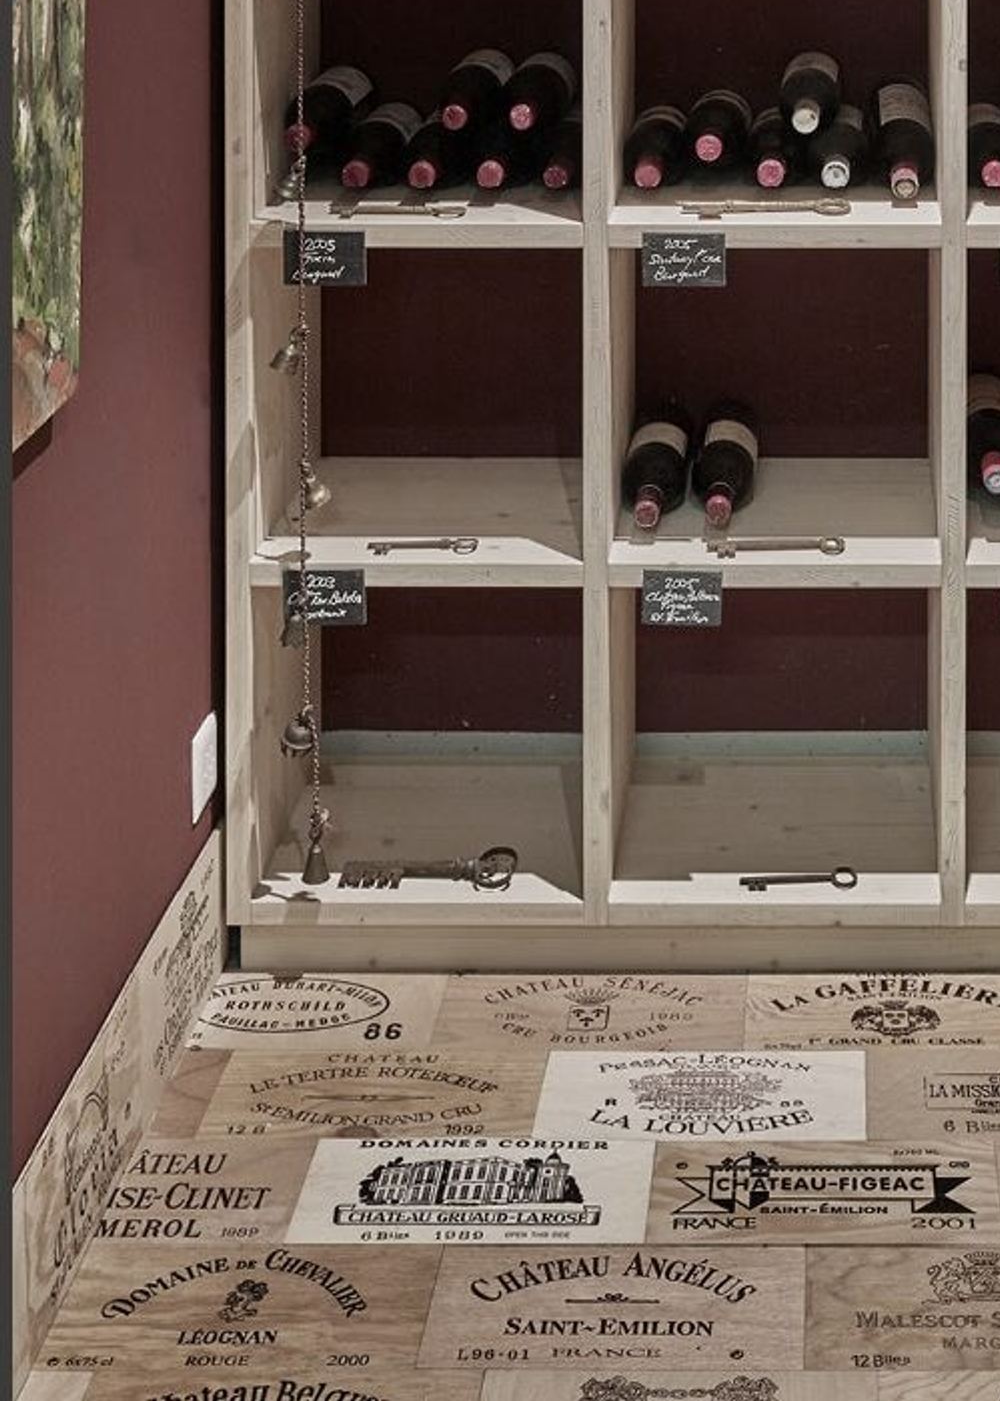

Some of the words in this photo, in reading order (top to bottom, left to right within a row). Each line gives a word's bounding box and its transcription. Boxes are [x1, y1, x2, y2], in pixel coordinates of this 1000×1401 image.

[304, 238, 336, 253] 2005
[485, 977, 586, 1005] CHATEAU
[225, 1001, 346, 1011] ROTHSCHILD
[771, 994, 808, 1012] LA
[363, 1022, 402, 1041] 86
[502, 1022, 537, 1038] CRU
[550, 1024, 668, 1044] BOURGEOIS
[829, 1038, 882, 1046] GRAND
[890, 1038, 921, 1046] CRU
[327, 1054, 440, 1063] CHATEAU
[249, 1078, 280, 1094] LE
[281, 1067, 369, 1085] TERTRE
[928, 1083, 949, 1098] LA
[363, 1112, 434, 1126] GRAND
[440, 1103, 482, 1120] CRU
[589, 1109, 631, 1130] LA
[225, 1124, 245, 1135] 12
[444, 1124, 485, 1135] 1992
[943, 1120, 956, 1133] 6
[360, 1139, 489, 1149] DOMAINES
[498, 1139, 609, 1150] CORDIER
[128, 1149, 227, 1175] ÂTEAU
[759, 1202, 889, 1215] SAINT-ÉMILION
[347, 1211, 433, 1224] CHATEAU
[436, 1211, 589, 1225] GRUAUD-LAROSE
[672, 1216, 757, 1231] FRANCE
[911, 1216, 976, 1230] 2001
[360, 1231, 371, 1241] 6
[433, 1230, 485, 1241] 1989
[101, 1257, 230, 1320] DOMAINE
[264, 1247, 369, 1319] CHEVALIER
[469, 1255, 611, 1303] CHÂTEAU
[621, 1251, 758, 1304] ANGÉLUS
[855, 1311, 982, 1329] MALESCOT
[176, 1329, 279, 1346] LÉOGNAN
[325, 1353, 371, 1367] 2000
[551, 1348, 663, 1358] FRANCE
[184, 1354, 250, 1367] ROUGE
[850, 1354, 870, 1368] 12
